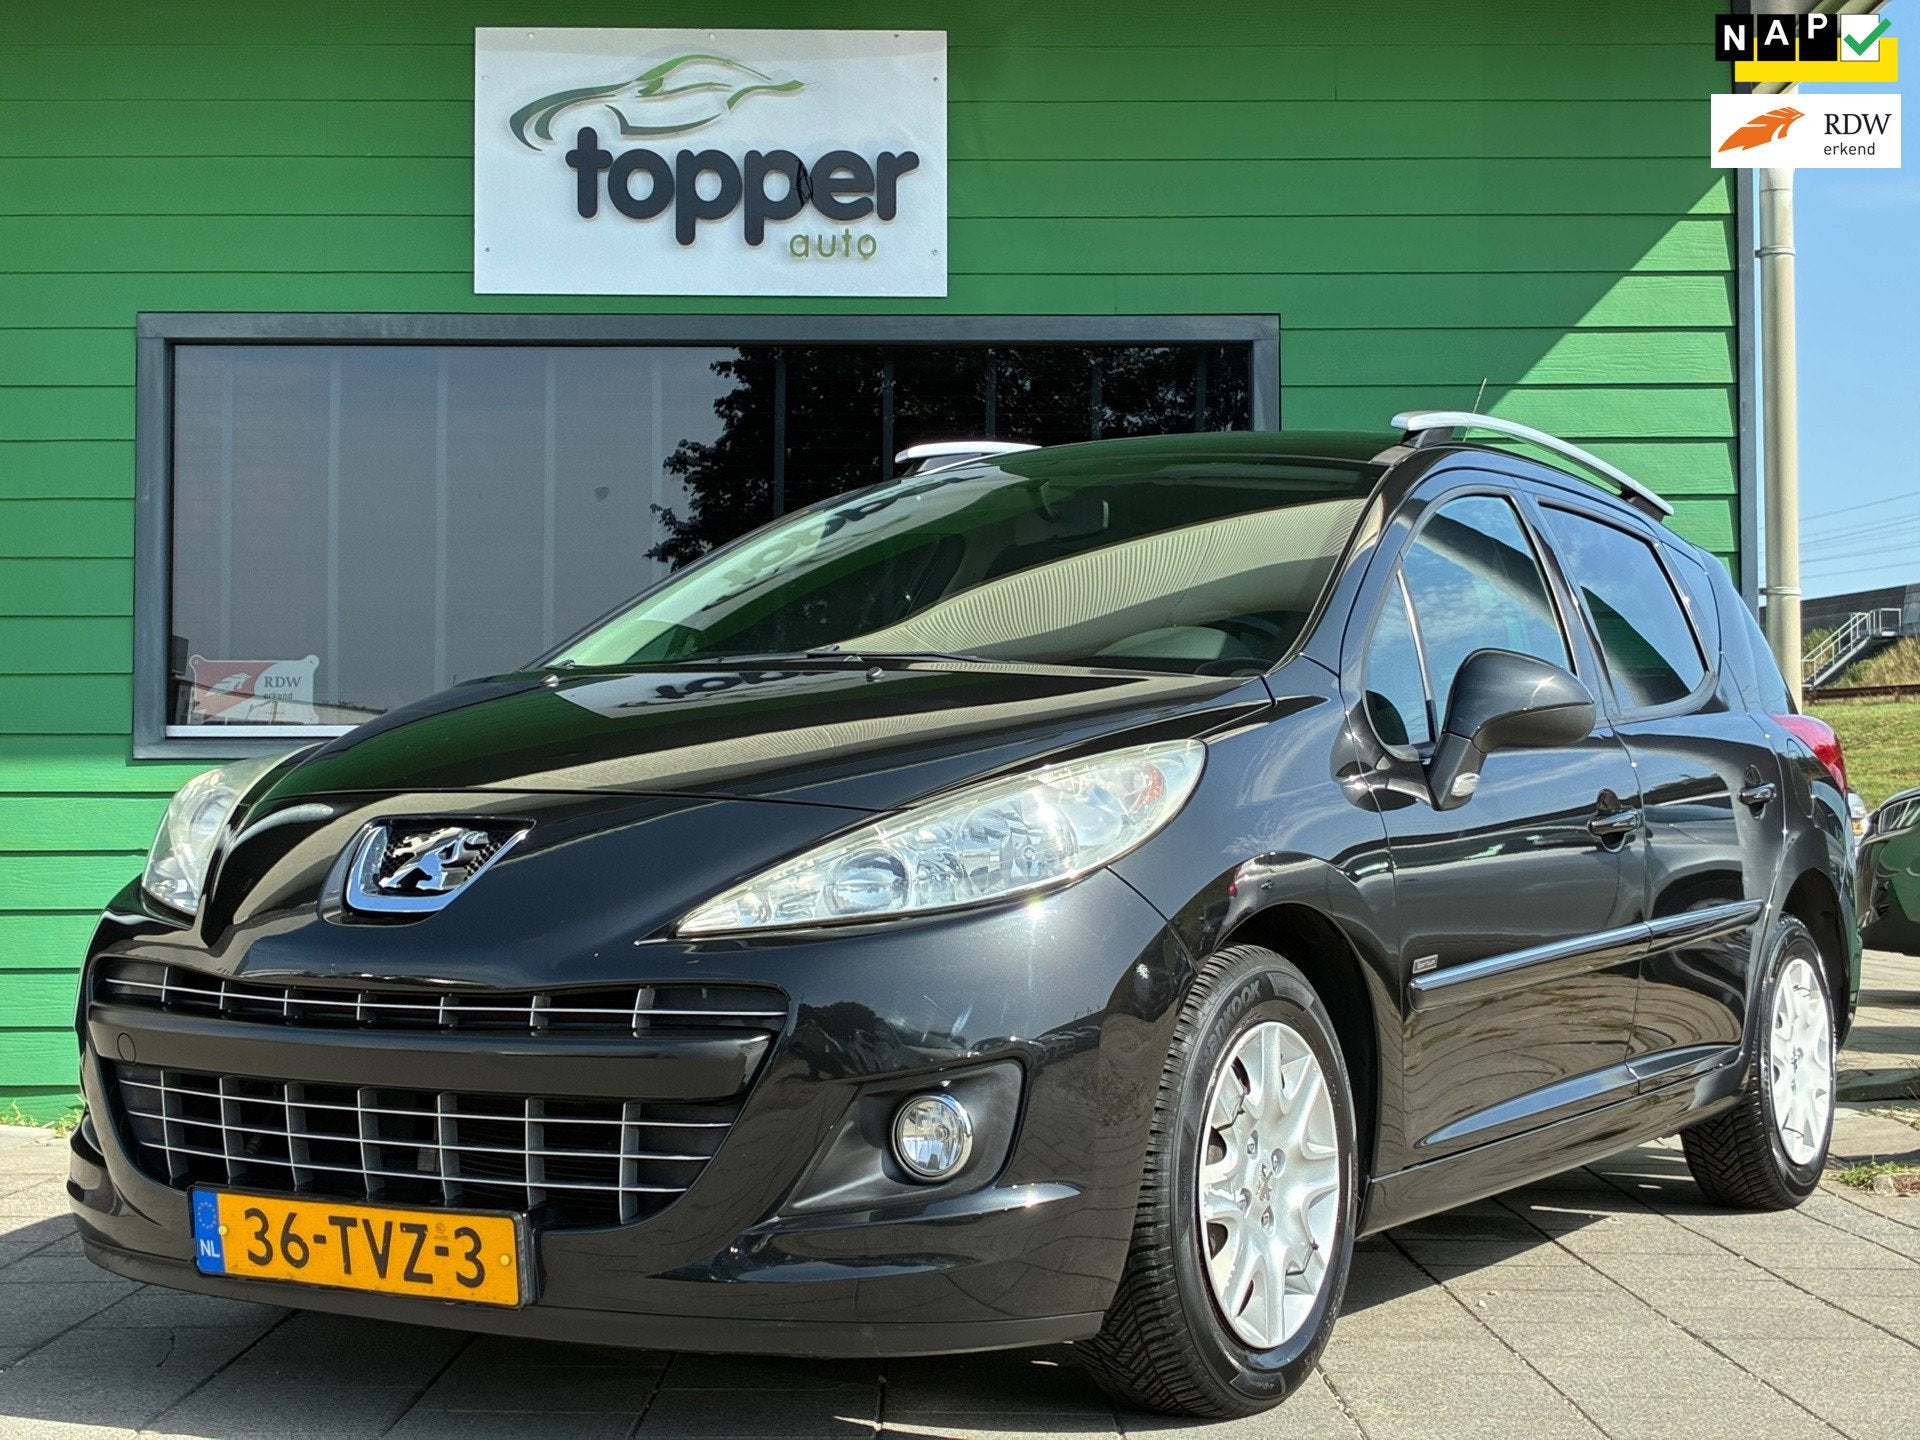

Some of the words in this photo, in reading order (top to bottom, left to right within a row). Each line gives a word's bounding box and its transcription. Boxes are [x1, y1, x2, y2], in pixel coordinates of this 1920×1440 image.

[565, 126, 920, 246] topper
[789, 228, 877, 260] auto
[264, 676, 302, 688] RDW
[263, 691, 293, 701] erkend
[200, 1239, 220, 1258] NL
[244, 1207, 486, 1289] 36-TVZ-3
